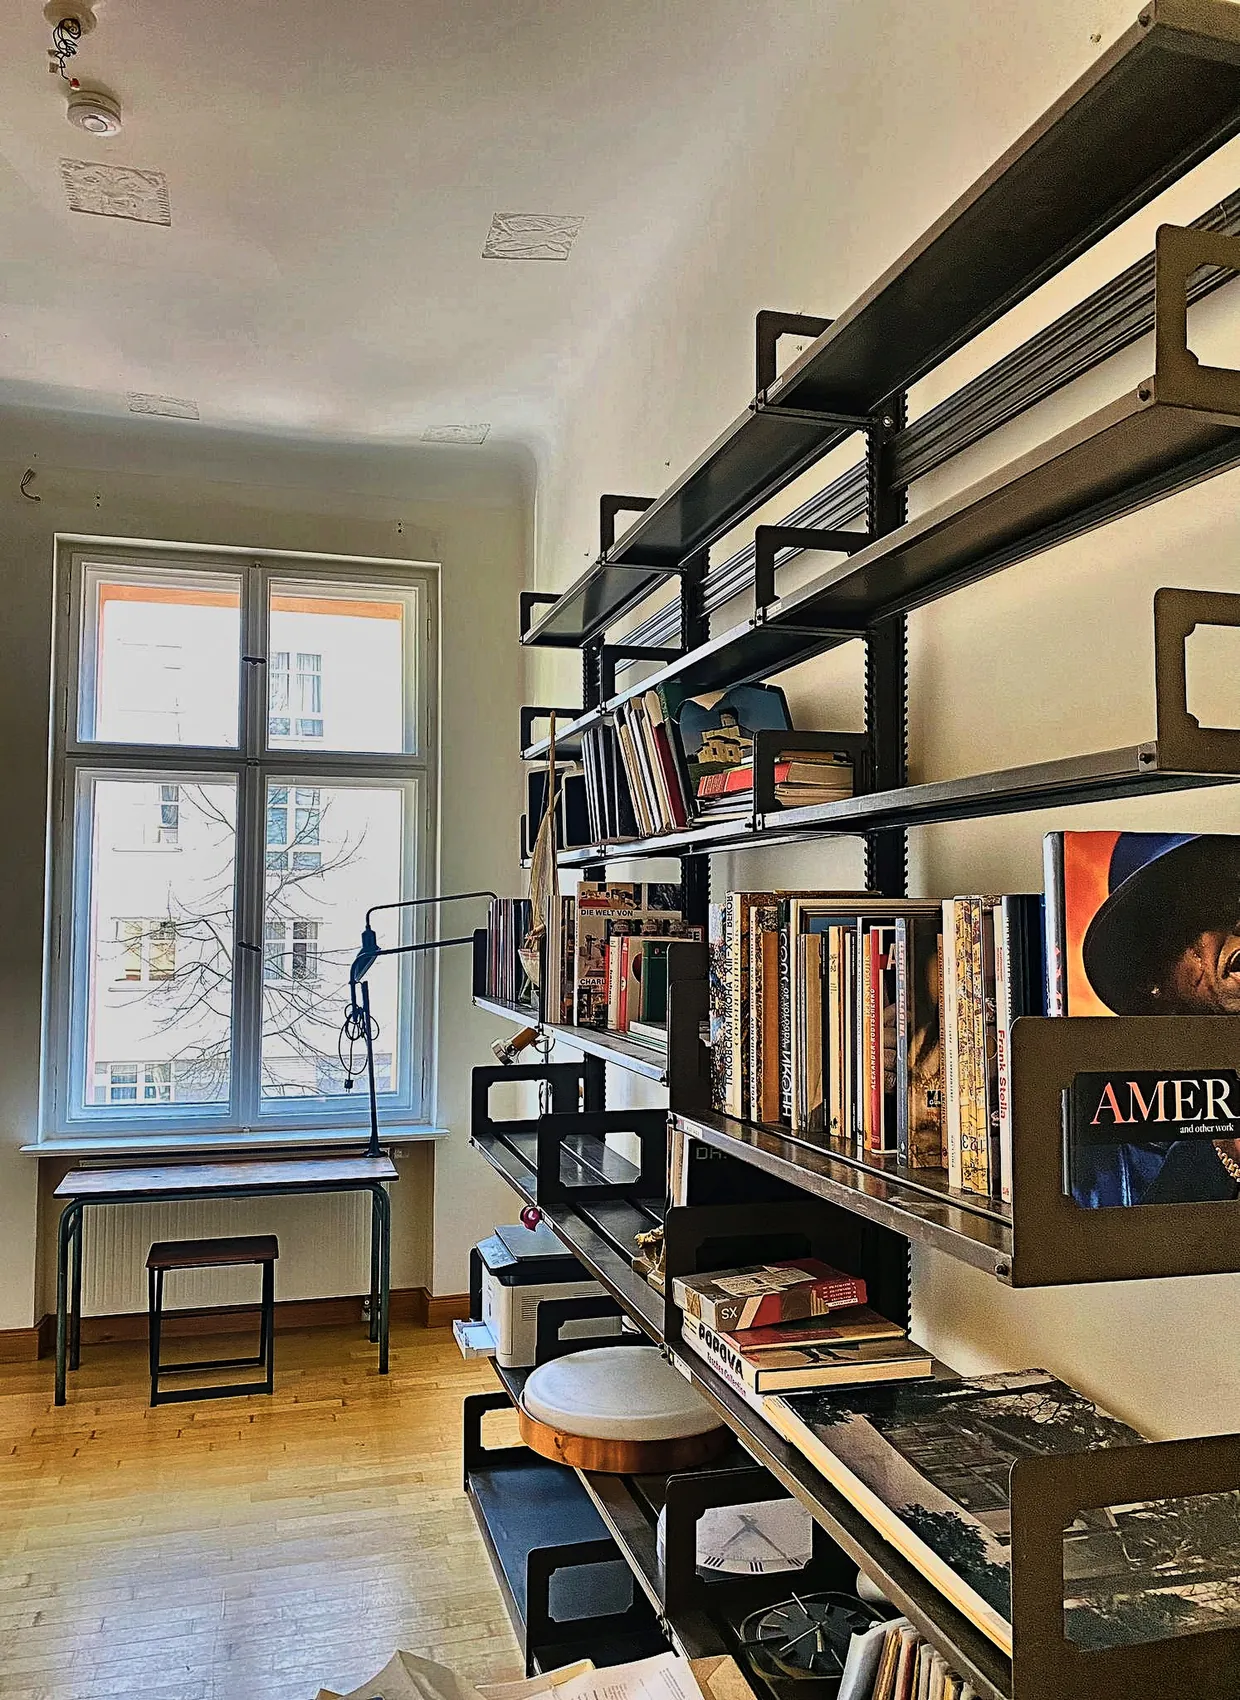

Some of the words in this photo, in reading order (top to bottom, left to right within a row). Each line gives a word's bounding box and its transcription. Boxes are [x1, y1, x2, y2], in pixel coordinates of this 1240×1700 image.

[580, 909, 594, 917] DIE
[595, 909, 614, 917] WELT
[725, 982, 733, 1018] ИКОНА
[998, 1029, 1006, 1071] Frank
[999, 1077, 1008, 1120] Stella
[1089, 1078, 1240, 1125] AMER
[1179, 1124, 1194, 1134] and
[1194, 1123, 1215, 1133] other
[1215, 1122, 1235, 1133] work
[721, 1306, 738, 1320] SX
[698, 1322, 745, 1381] POPOVA
